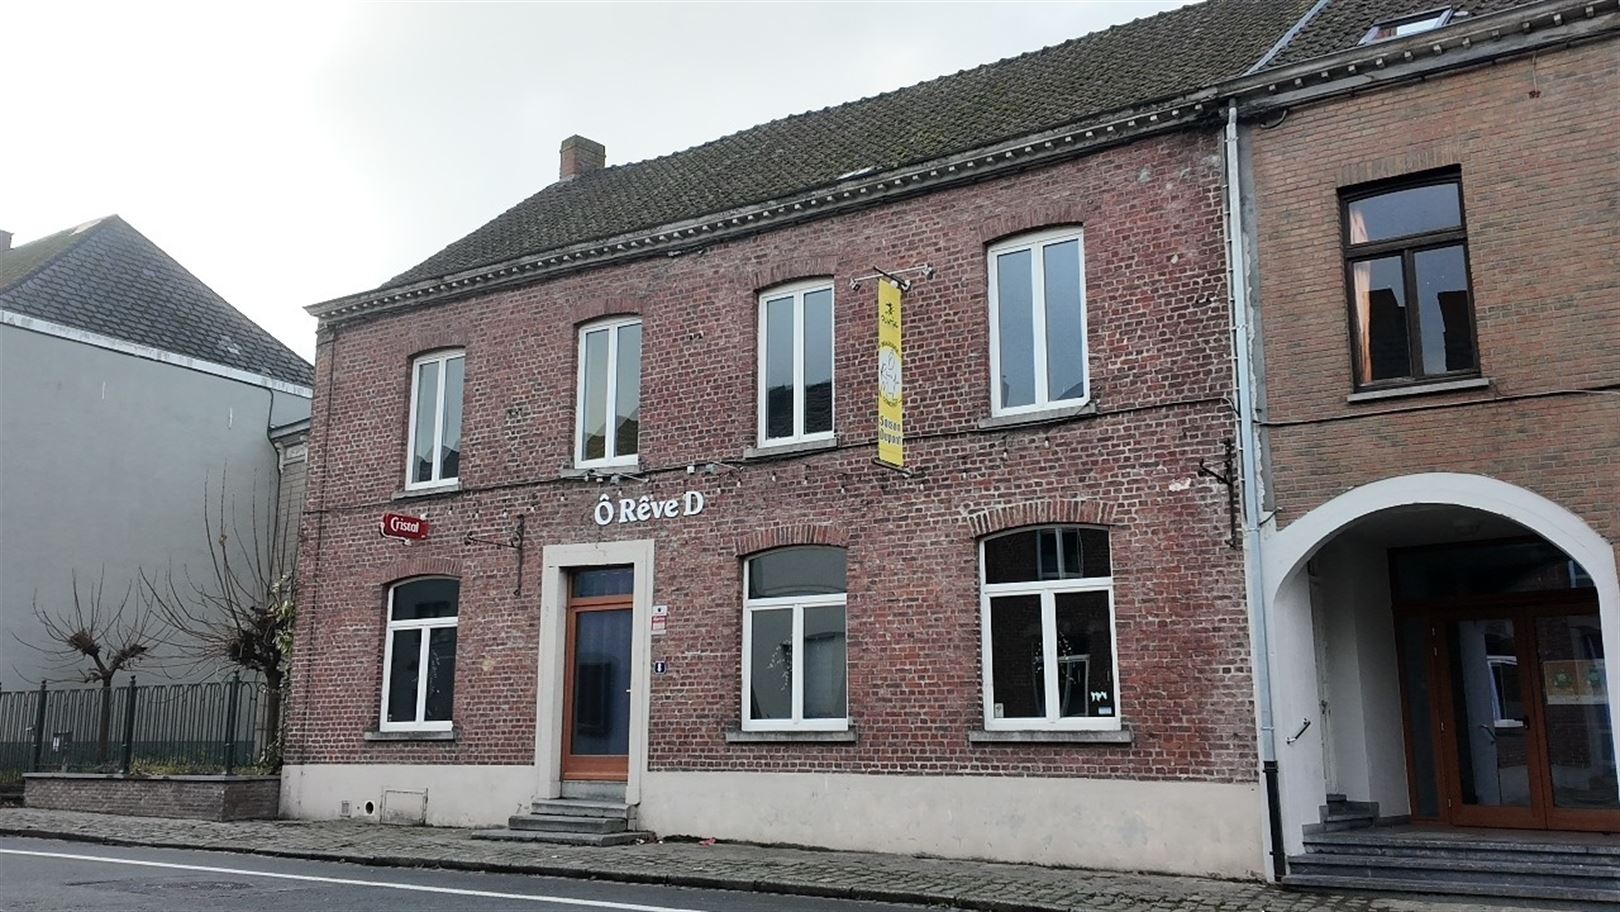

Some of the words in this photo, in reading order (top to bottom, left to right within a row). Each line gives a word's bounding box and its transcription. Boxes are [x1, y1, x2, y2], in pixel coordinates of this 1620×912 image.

[594, 493, 614, 526] Ô
[618, 495, 680, 524] Rêve
[683, 491, 705, 517] D
[390, 516, 420, 533] Cristal
